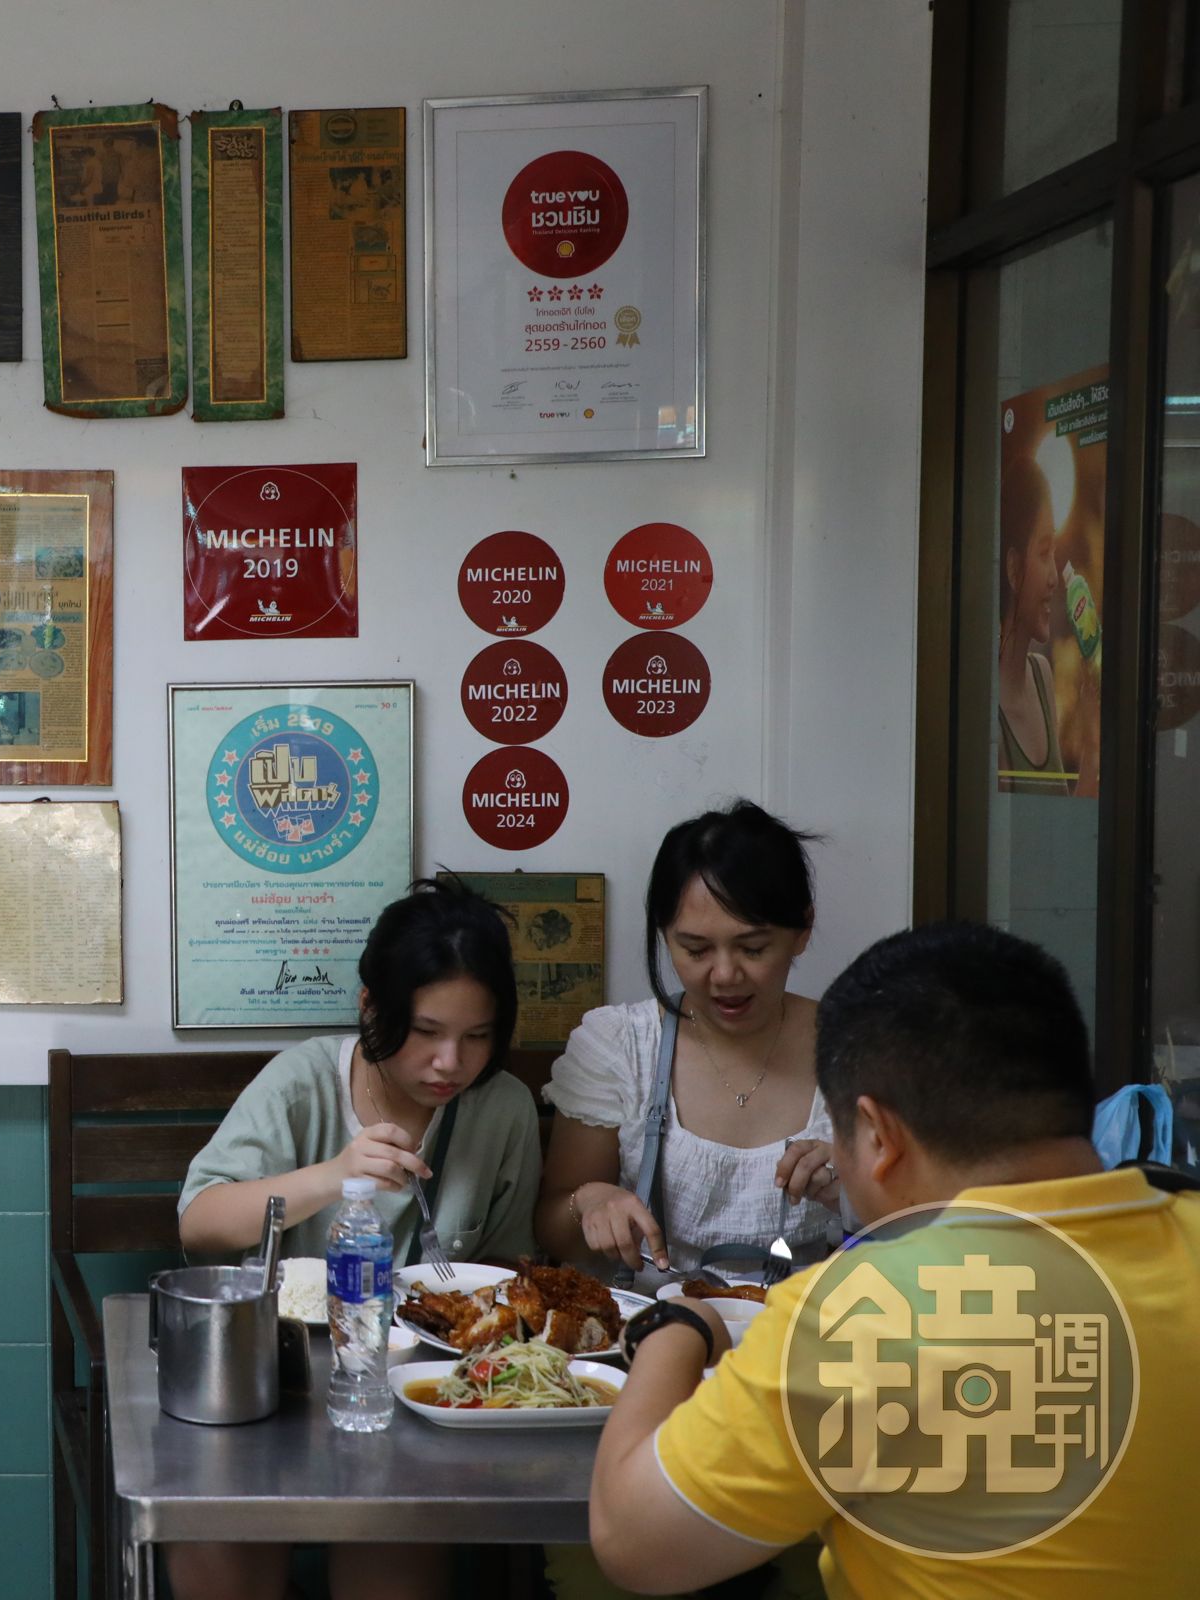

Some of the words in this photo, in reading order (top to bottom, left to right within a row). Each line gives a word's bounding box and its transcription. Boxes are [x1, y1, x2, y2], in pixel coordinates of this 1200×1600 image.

[530, 190, 566, 204] true
[57, 211, 110, 223] Beautiful
[113, 209, 145, 220] Birds
[531, 205, 600, 228] ชวนชิม
[524, 319, 607, 335] สุดยอดร้านไก่ทอด
[524, 337, 560, 352] 2559
[570, 336, 606, 350] 2560
[206, 527, 335, 549] MICHELIN
[243, 558, 299, 579] 2019
[466, 566, 558, 583] MICHELIN
[616, 559, 701, 574] MICHELIN
[640, 578, 674, 592] 2021
[492, 589, 532, 605] 2020
[468, 682, 561, 701] MICHELIN
[612, 678, 701, 694] MICHELIN
[491, 704, 538, 723] 2022
[636, 700, 676, 714] 2023
[471, 792, 560, 808] MICHELIN
[496, 814, 536, 828] 2024
[233, 830, 290, 865] แม่ช้อย
[299, 829, 352, 864] นางรำ
[251, 892, 292, 904] แม่ช้อย
[297, 891, 335, 904] นางรำ
